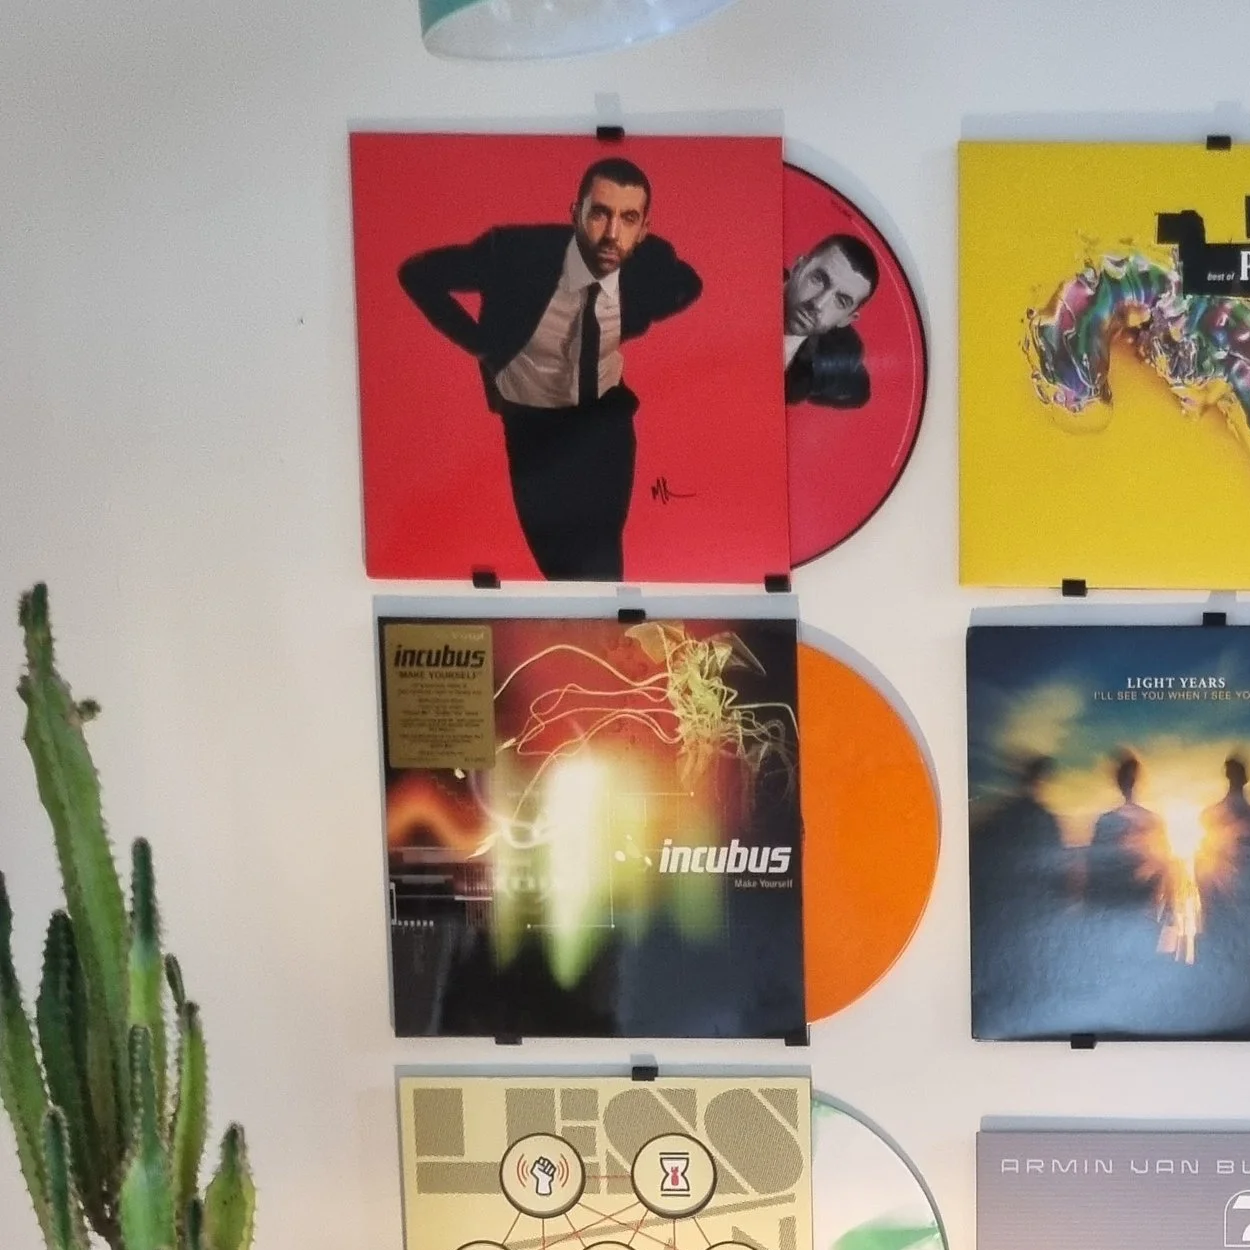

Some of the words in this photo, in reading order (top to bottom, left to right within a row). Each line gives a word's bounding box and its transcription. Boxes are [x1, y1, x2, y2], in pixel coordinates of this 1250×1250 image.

[1226, 272, 1235, 281] of
[394, 644, 486, 668] incubus
[1127, 677, 1175, 689] LIGHT
[1180, 677, 1226, 689] YEARS
[1094, 691, 1113, 700] I'LL
[1117, 691, 1137, 700] SEE
[1141, 691, 1164, 700] YOU
[1168, 691, 1200, 700] WHEN
[1211, 691, 1232, 700] SEE
[659, 838, 792, 873] incubus
[734, 879, 757, 889] Make
[760, 878, 793, 889] Yourself
[1001, 1159, 1113, 1175] ARMIN
[1130, 1159, 1199, 1175] VAN
